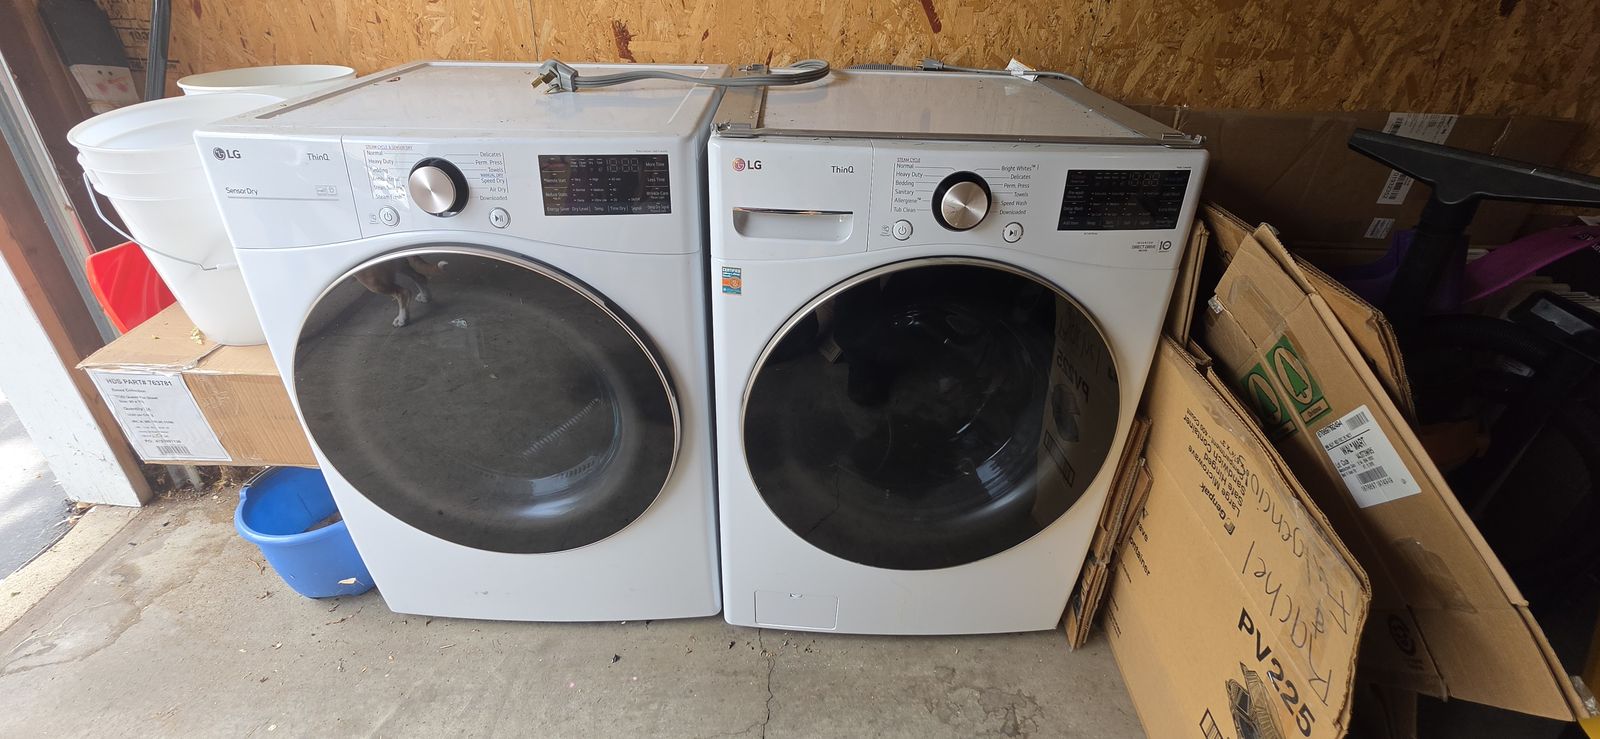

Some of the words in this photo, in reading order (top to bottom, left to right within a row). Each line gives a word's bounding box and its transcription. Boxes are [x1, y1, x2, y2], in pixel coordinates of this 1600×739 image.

[227, 149, 241, 159] LG
[307, 152, 330, 161] ThinQ
[748, 160, 762, 170] LG
[832, 164, 854, 174] ThinQ
[895, 188, 914, 196] Sanitary
[1183, 414, 1212, 453] Container
[1187, 445, 1220, 492] Microwave
[1202, 455, 1228, 489] Hinged
[1212, 448, 1248, 496] Sandwich
[1200, 482, 1226, 520] Genpak
[1222, 486, 1240, 518] Large
[1226, 483, 1244, 507] Safe
[1128, 536, 1150, 576] ontainer
[1242, 541, 1332, 706] Rachel
[1238, 607, 1315, 738] PV225
